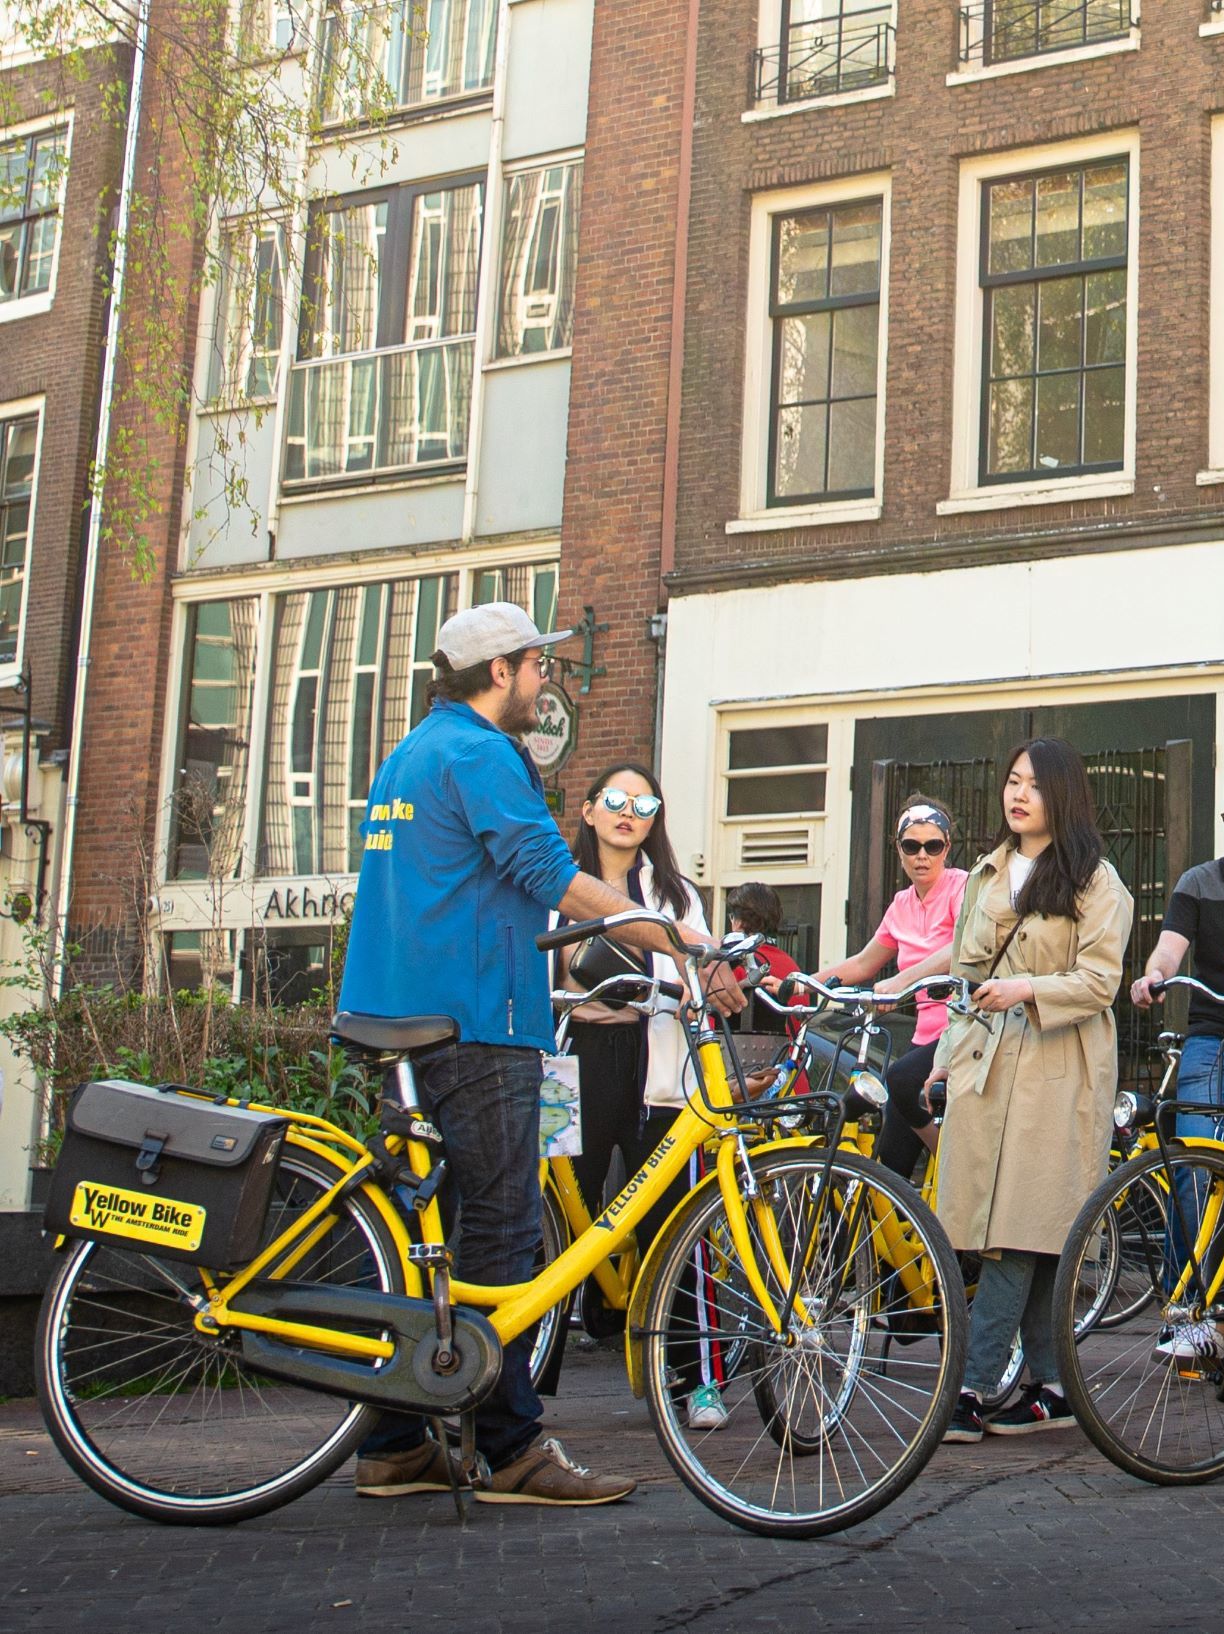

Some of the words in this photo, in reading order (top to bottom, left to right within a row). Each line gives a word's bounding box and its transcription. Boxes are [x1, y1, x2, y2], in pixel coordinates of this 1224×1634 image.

[594, 1169, 649, 1232] YELLOW
[646, 1135, 676, 1168] BIKE
[84, 1187, 147, 1218] Yellow
[151, 1203, 193, 1228] Bike
[126, 1217, 171, 1233] AMSTERDAM
